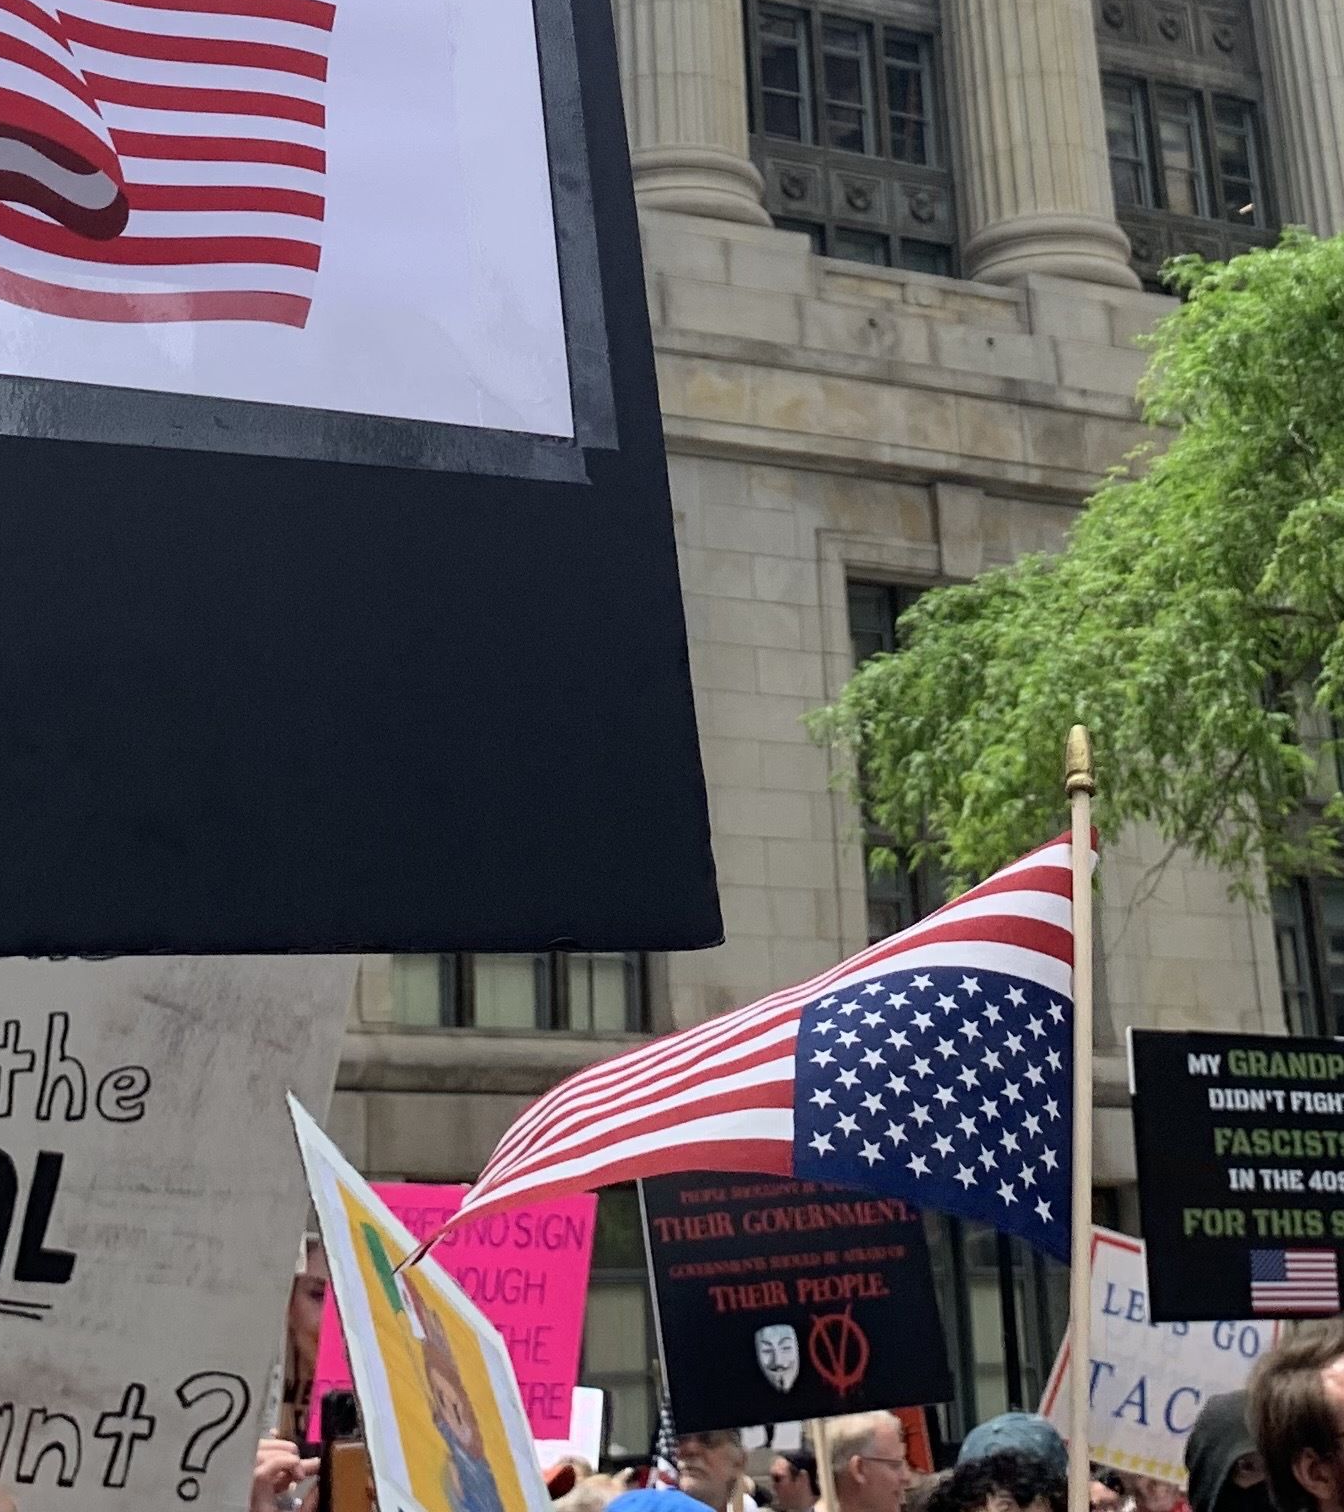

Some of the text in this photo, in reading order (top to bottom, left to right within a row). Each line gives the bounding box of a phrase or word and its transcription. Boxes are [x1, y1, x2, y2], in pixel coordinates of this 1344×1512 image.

[1187, 1053, 1221, 1076] MY
[1208, 1088, 1285, 1112] DIDN'T
[1228, 1168, 1255, 1192] IN
[1259, 1168, 1305, 1192] THE
[514, 1211, 587, 1252] SIGN
[654, 1211, 736, 1243] THEIR
[1183, 1208, 1246, 1236] FOR
[1252, 1208, 1325, 1238] THIS
[709, 1280, 788, 1312] THEIR
[1212, 1320, 1260, 1359] GO
